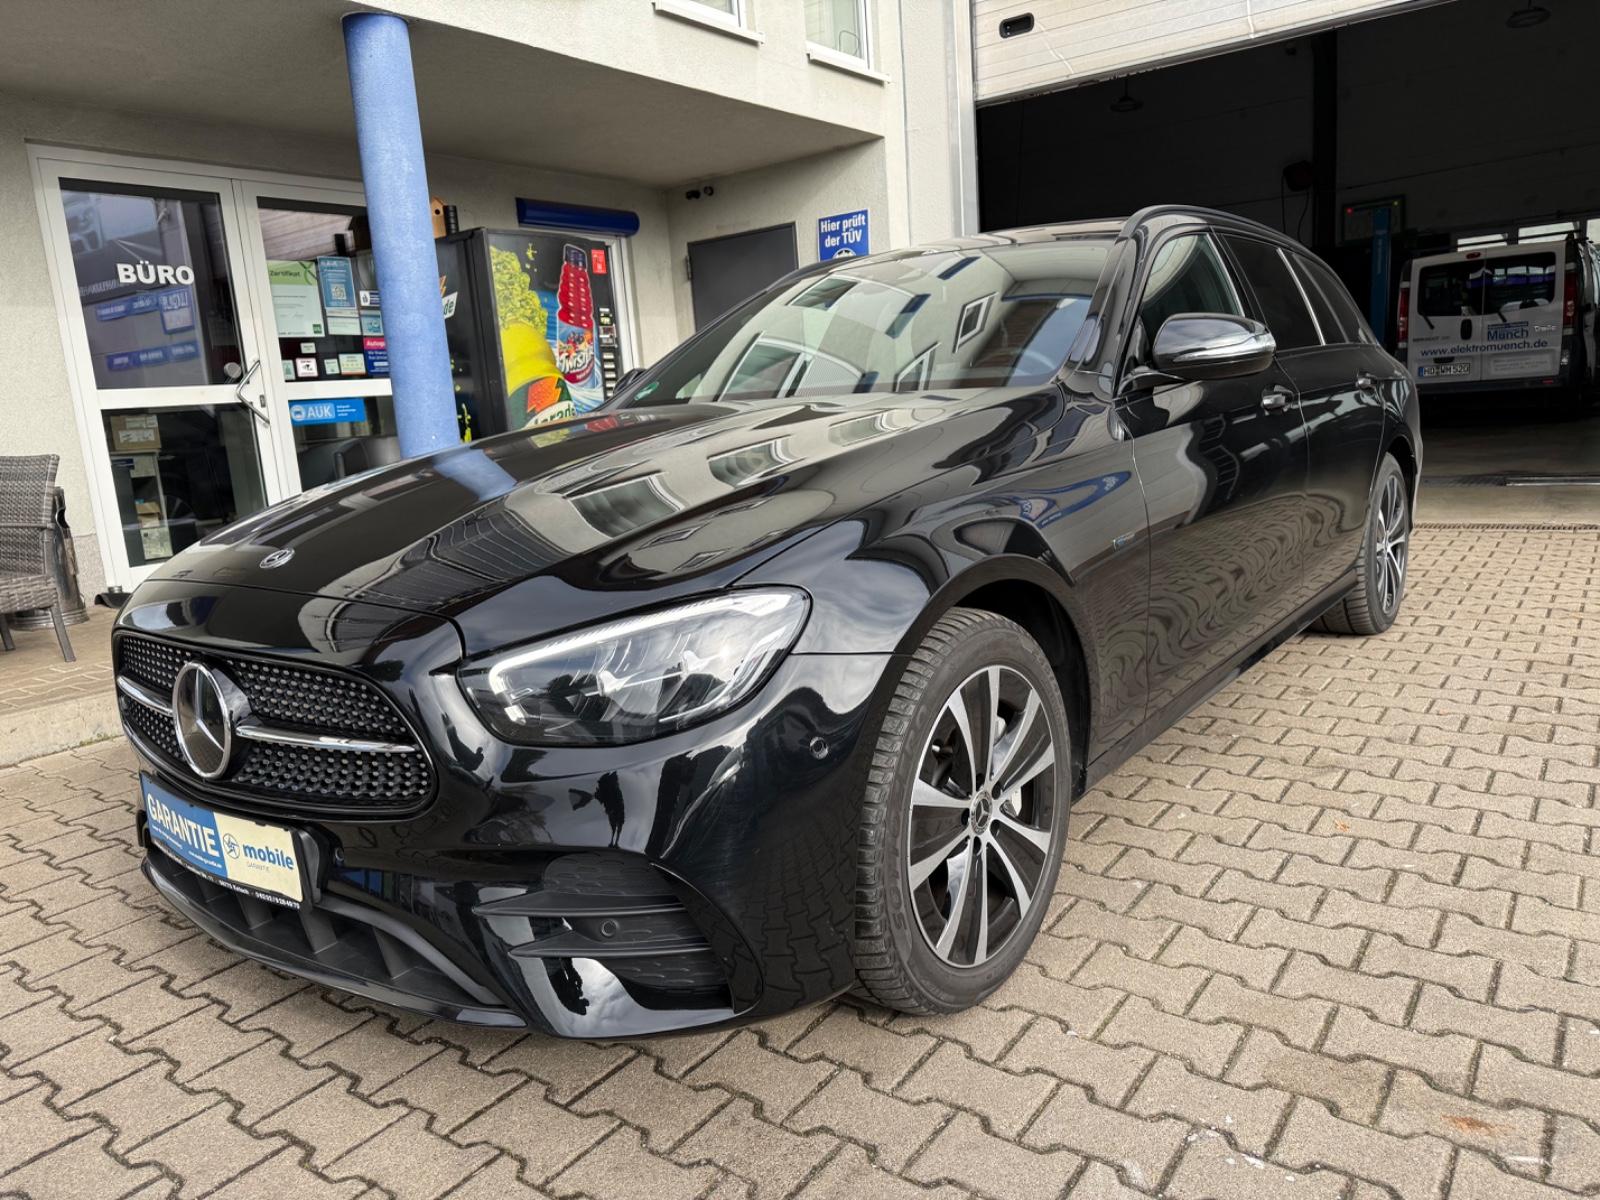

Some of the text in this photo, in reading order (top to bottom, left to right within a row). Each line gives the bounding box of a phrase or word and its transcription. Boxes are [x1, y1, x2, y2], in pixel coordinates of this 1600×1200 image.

[821, 213, 866, 233] Hier prüft
[825, 228, 862, 248] der TÜV
[117, 260, 195, 285] BÜRO
[1420, 338, 1549, 357] www.elektromuench.de
[307, 405, 332, 419] AUK
[147, 793, 220, 858] GARANTIE
[242, 844, 294, 871] mobile
